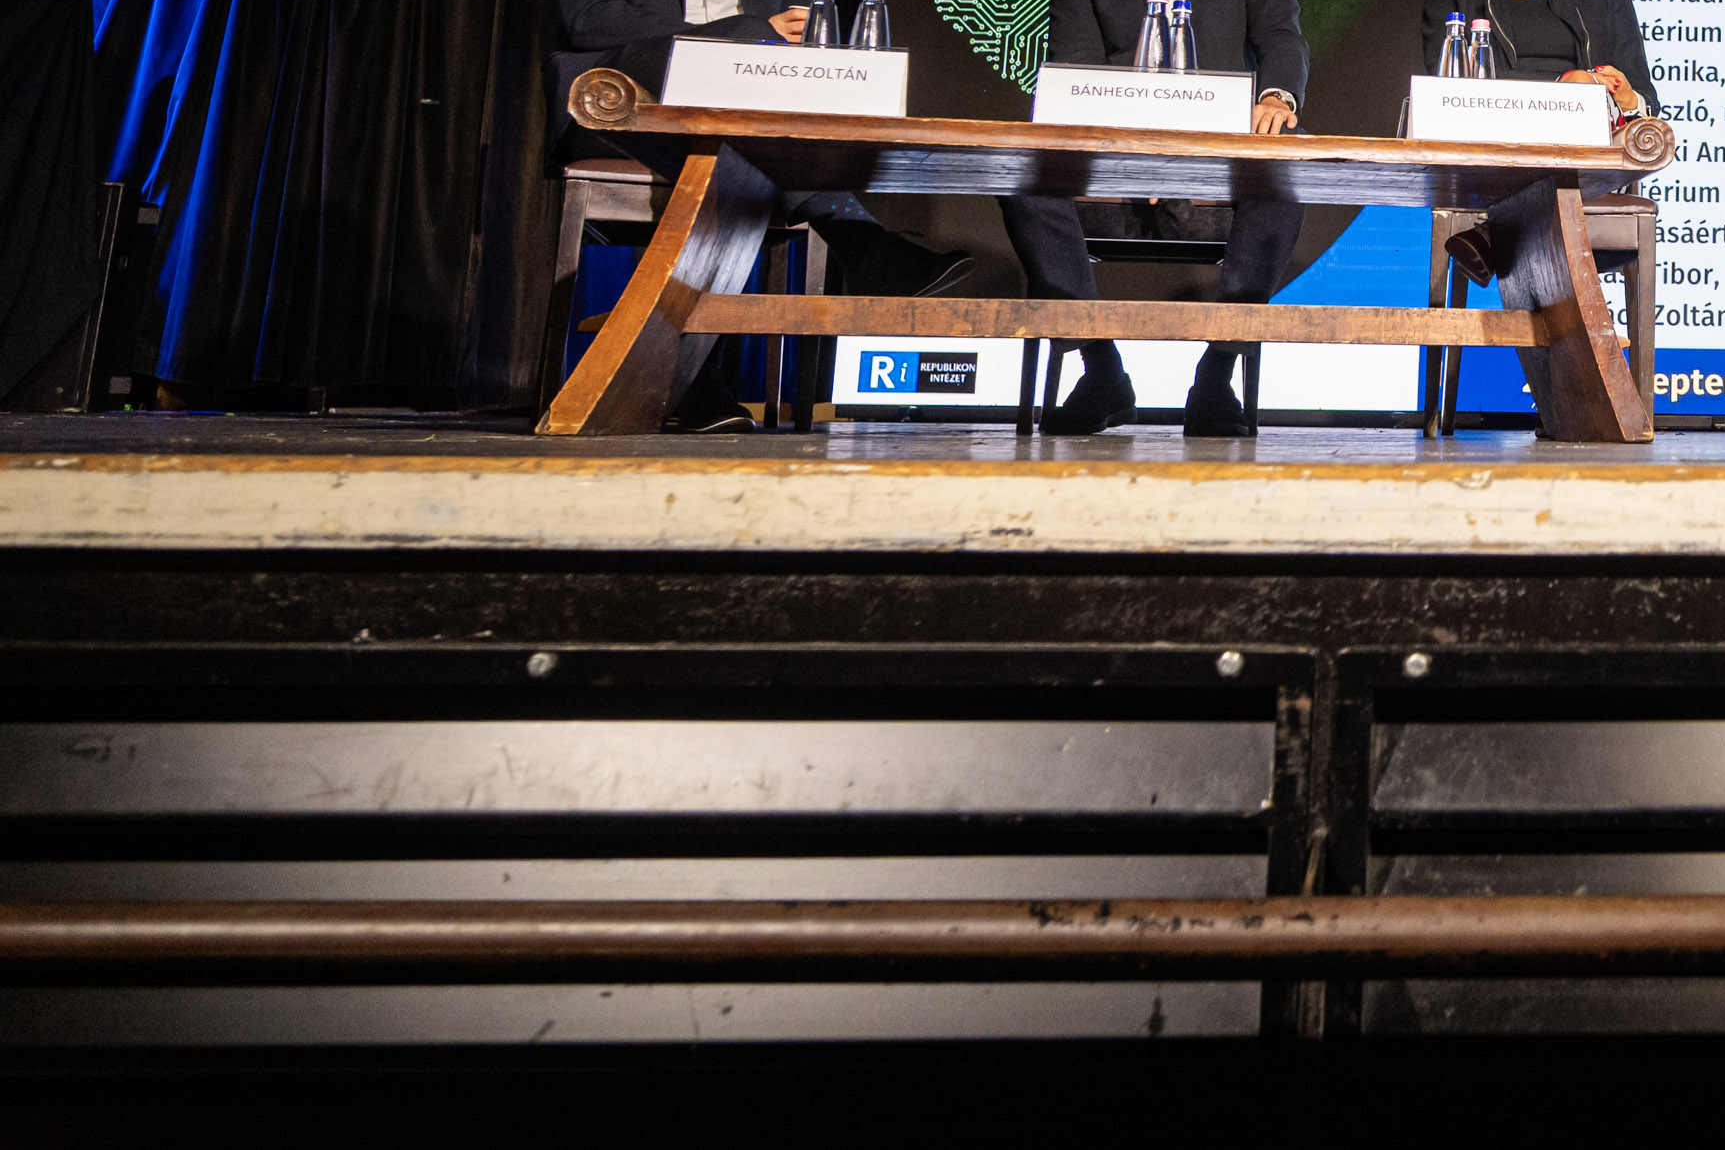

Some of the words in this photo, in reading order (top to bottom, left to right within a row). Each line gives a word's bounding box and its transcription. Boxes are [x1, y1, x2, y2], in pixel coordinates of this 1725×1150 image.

[1640, 18, 1722, 43] térium
[733, 61, 799, 78] TANÁCS
[803, 64, 868, 81] ZOLTÁN
[1651, 57, 1725, 88] ónika,
[1071, 83, 1149, 98] BÁNHEGYI
[1153, 87, 1215, 102] CSANÁD
[1442, 96, 1524, 110] POLERECZKI
[1528, 100, 1585, 113] ANDREA
[1660, 98, 1715, 127] szló,
[1640, 178, 1720, 203] térium
[1656, 261, 1719, 291] ibor,
[920, 362, 976, 373] REPUBLIKON
[929, 372, 966, 383] INTÉZET
